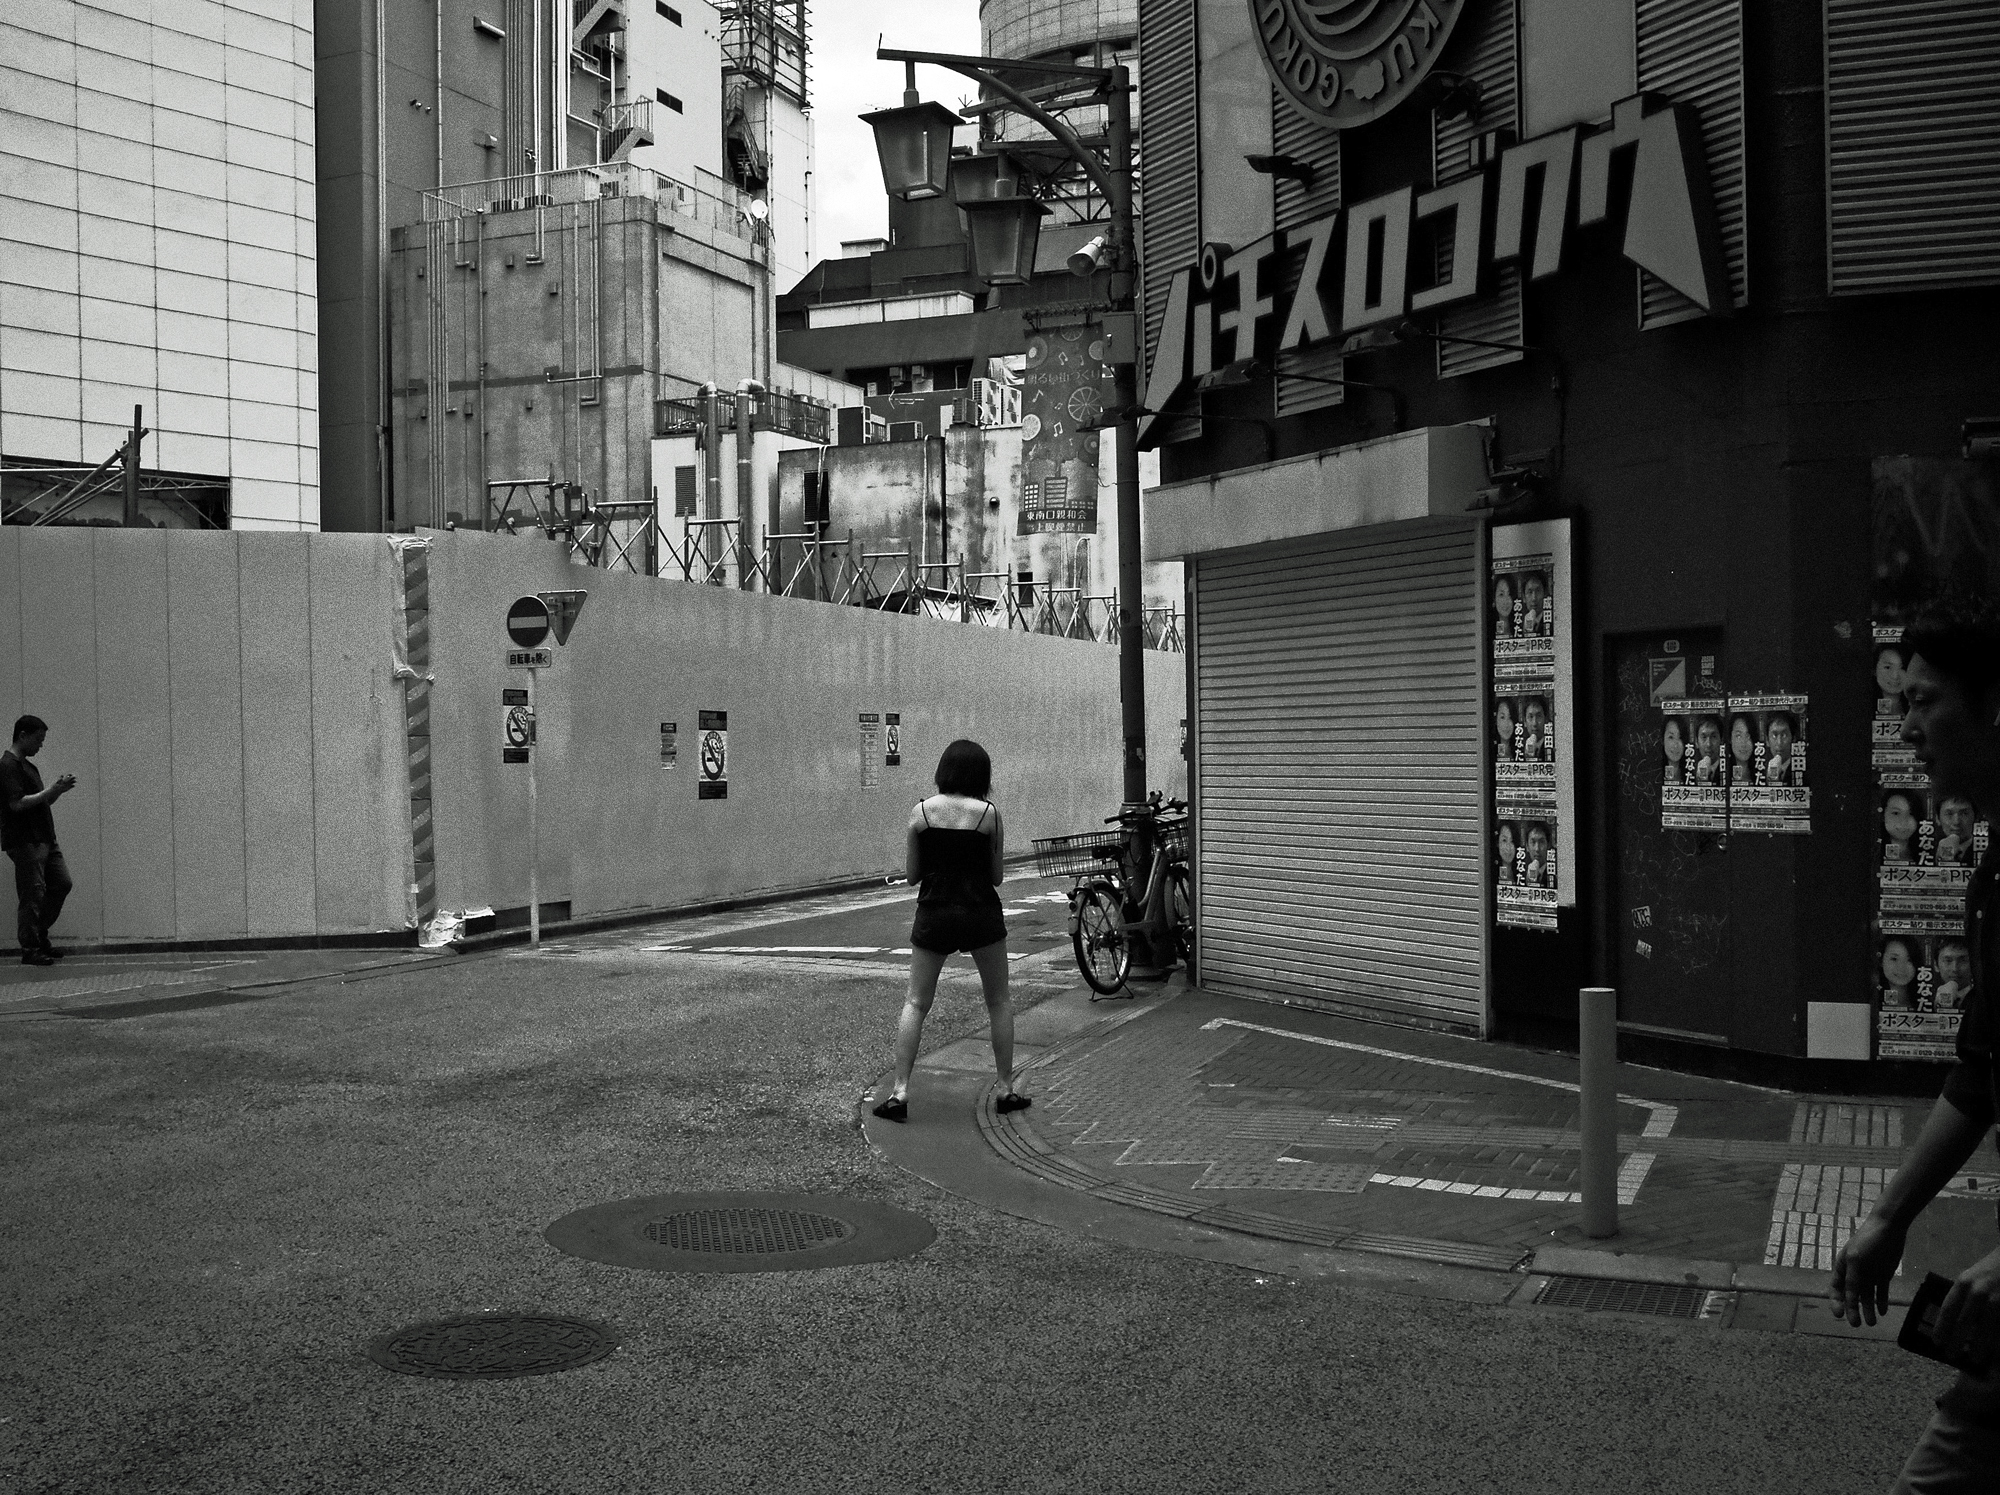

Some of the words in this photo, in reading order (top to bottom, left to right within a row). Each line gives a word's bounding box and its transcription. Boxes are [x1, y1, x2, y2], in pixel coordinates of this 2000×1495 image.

[1260, 0, 1340, 108] GOKU
[1026, 509, 1087, 521] 東南口親和会
[1513, 598, 1523, 638] あなた
[1495, 640, 1526, 653] ポスター
[509, 652, 548, 665] 自転車を除く
[1876, 722, 1902, 736] ポス
[1514, 722, 1524, 762] あなた
[1684, 743, 1695, 786] あなた
[1754, 741, 1766, 787] あなた
[1790, 740, 1807, 772] 成田
[1497, 764, 1528, 776] ポスター
[1532, 764, 1554, 776] PR党
[1664, 787, 1699, 801] ポスター
[1731, 788, 1769, 802] ポスター
[1776, 788, 1806, 802] PR党
[1918, 819, 1935, 866] あなた
[1972, 820, 1990, 852] 成田
[1516, 846, 1526, 886] あなた
[1884, 868, 1940, 882] ポスター
[1950, 869, 1972, 883] PR
[1498, 886, 1529, 899] ポスター
[1533, 890, 1556, 903] PR党
[1925, 921, 1966, 930] 掲示交渉代
[1916, 965, 1933, 1013] あなた
[1882, 1013, 1939, 1028] ポスター
